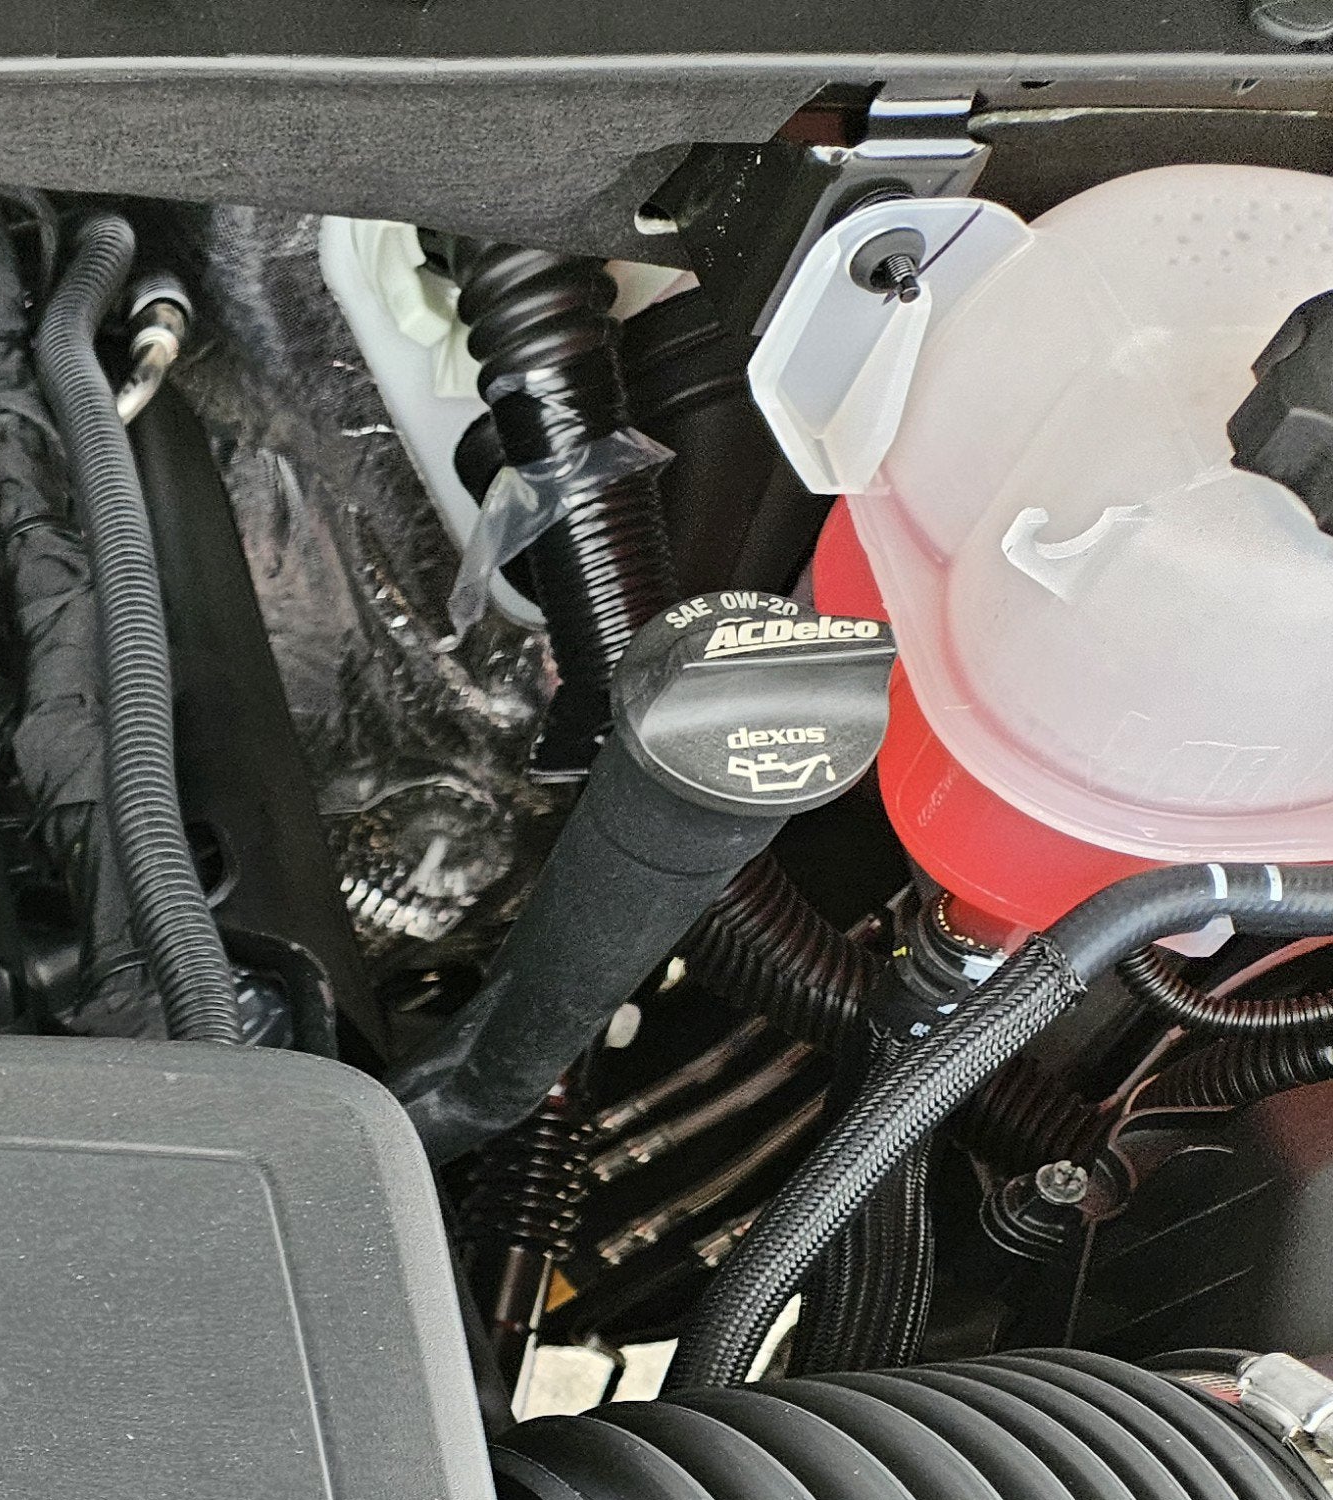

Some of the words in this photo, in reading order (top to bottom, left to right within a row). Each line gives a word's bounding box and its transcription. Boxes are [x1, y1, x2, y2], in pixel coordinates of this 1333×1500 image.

[665, 598, 712, 629] SAE
[720, 592, 798, 616] 0W-20
[704, 616, 880, 652] ACDelco
[727, 727, 827, 749] dexos
